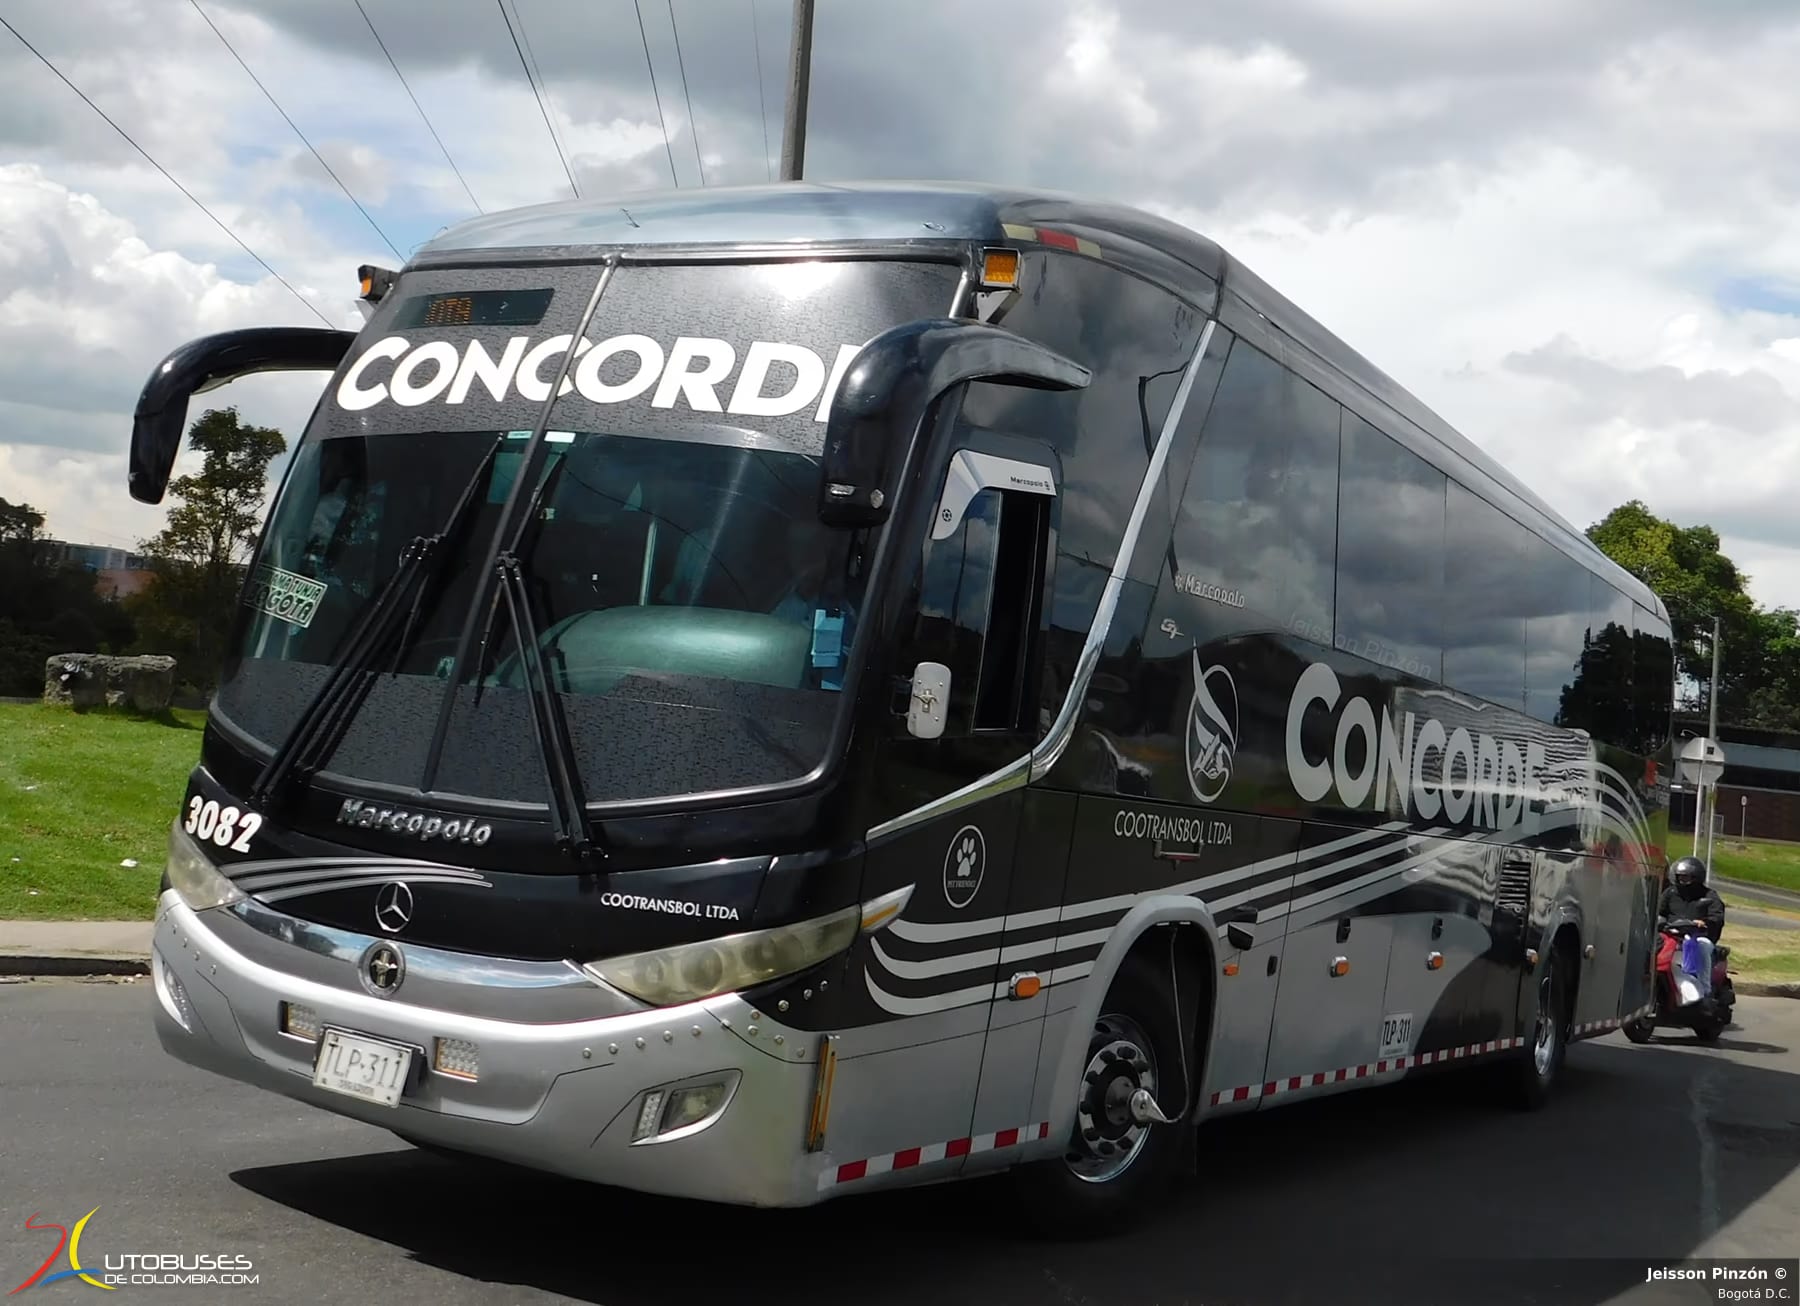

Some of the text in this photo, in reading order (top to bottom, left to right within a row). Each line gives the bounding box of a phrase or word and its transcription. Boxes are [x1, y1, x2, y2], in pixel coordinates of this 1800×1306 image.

[1185, 574, 1245, 608] Marcopolo
[1286, 662, 1545, 836] CONCORDE
[185, 795, 262, 853] 3082
[336, 799, 492, 846] Marcopolo
[1114, 810, 1232, 845] COOTRANSBOL LTDA
[601, 892, 740, 921] COOTRANSBOL LTDA
